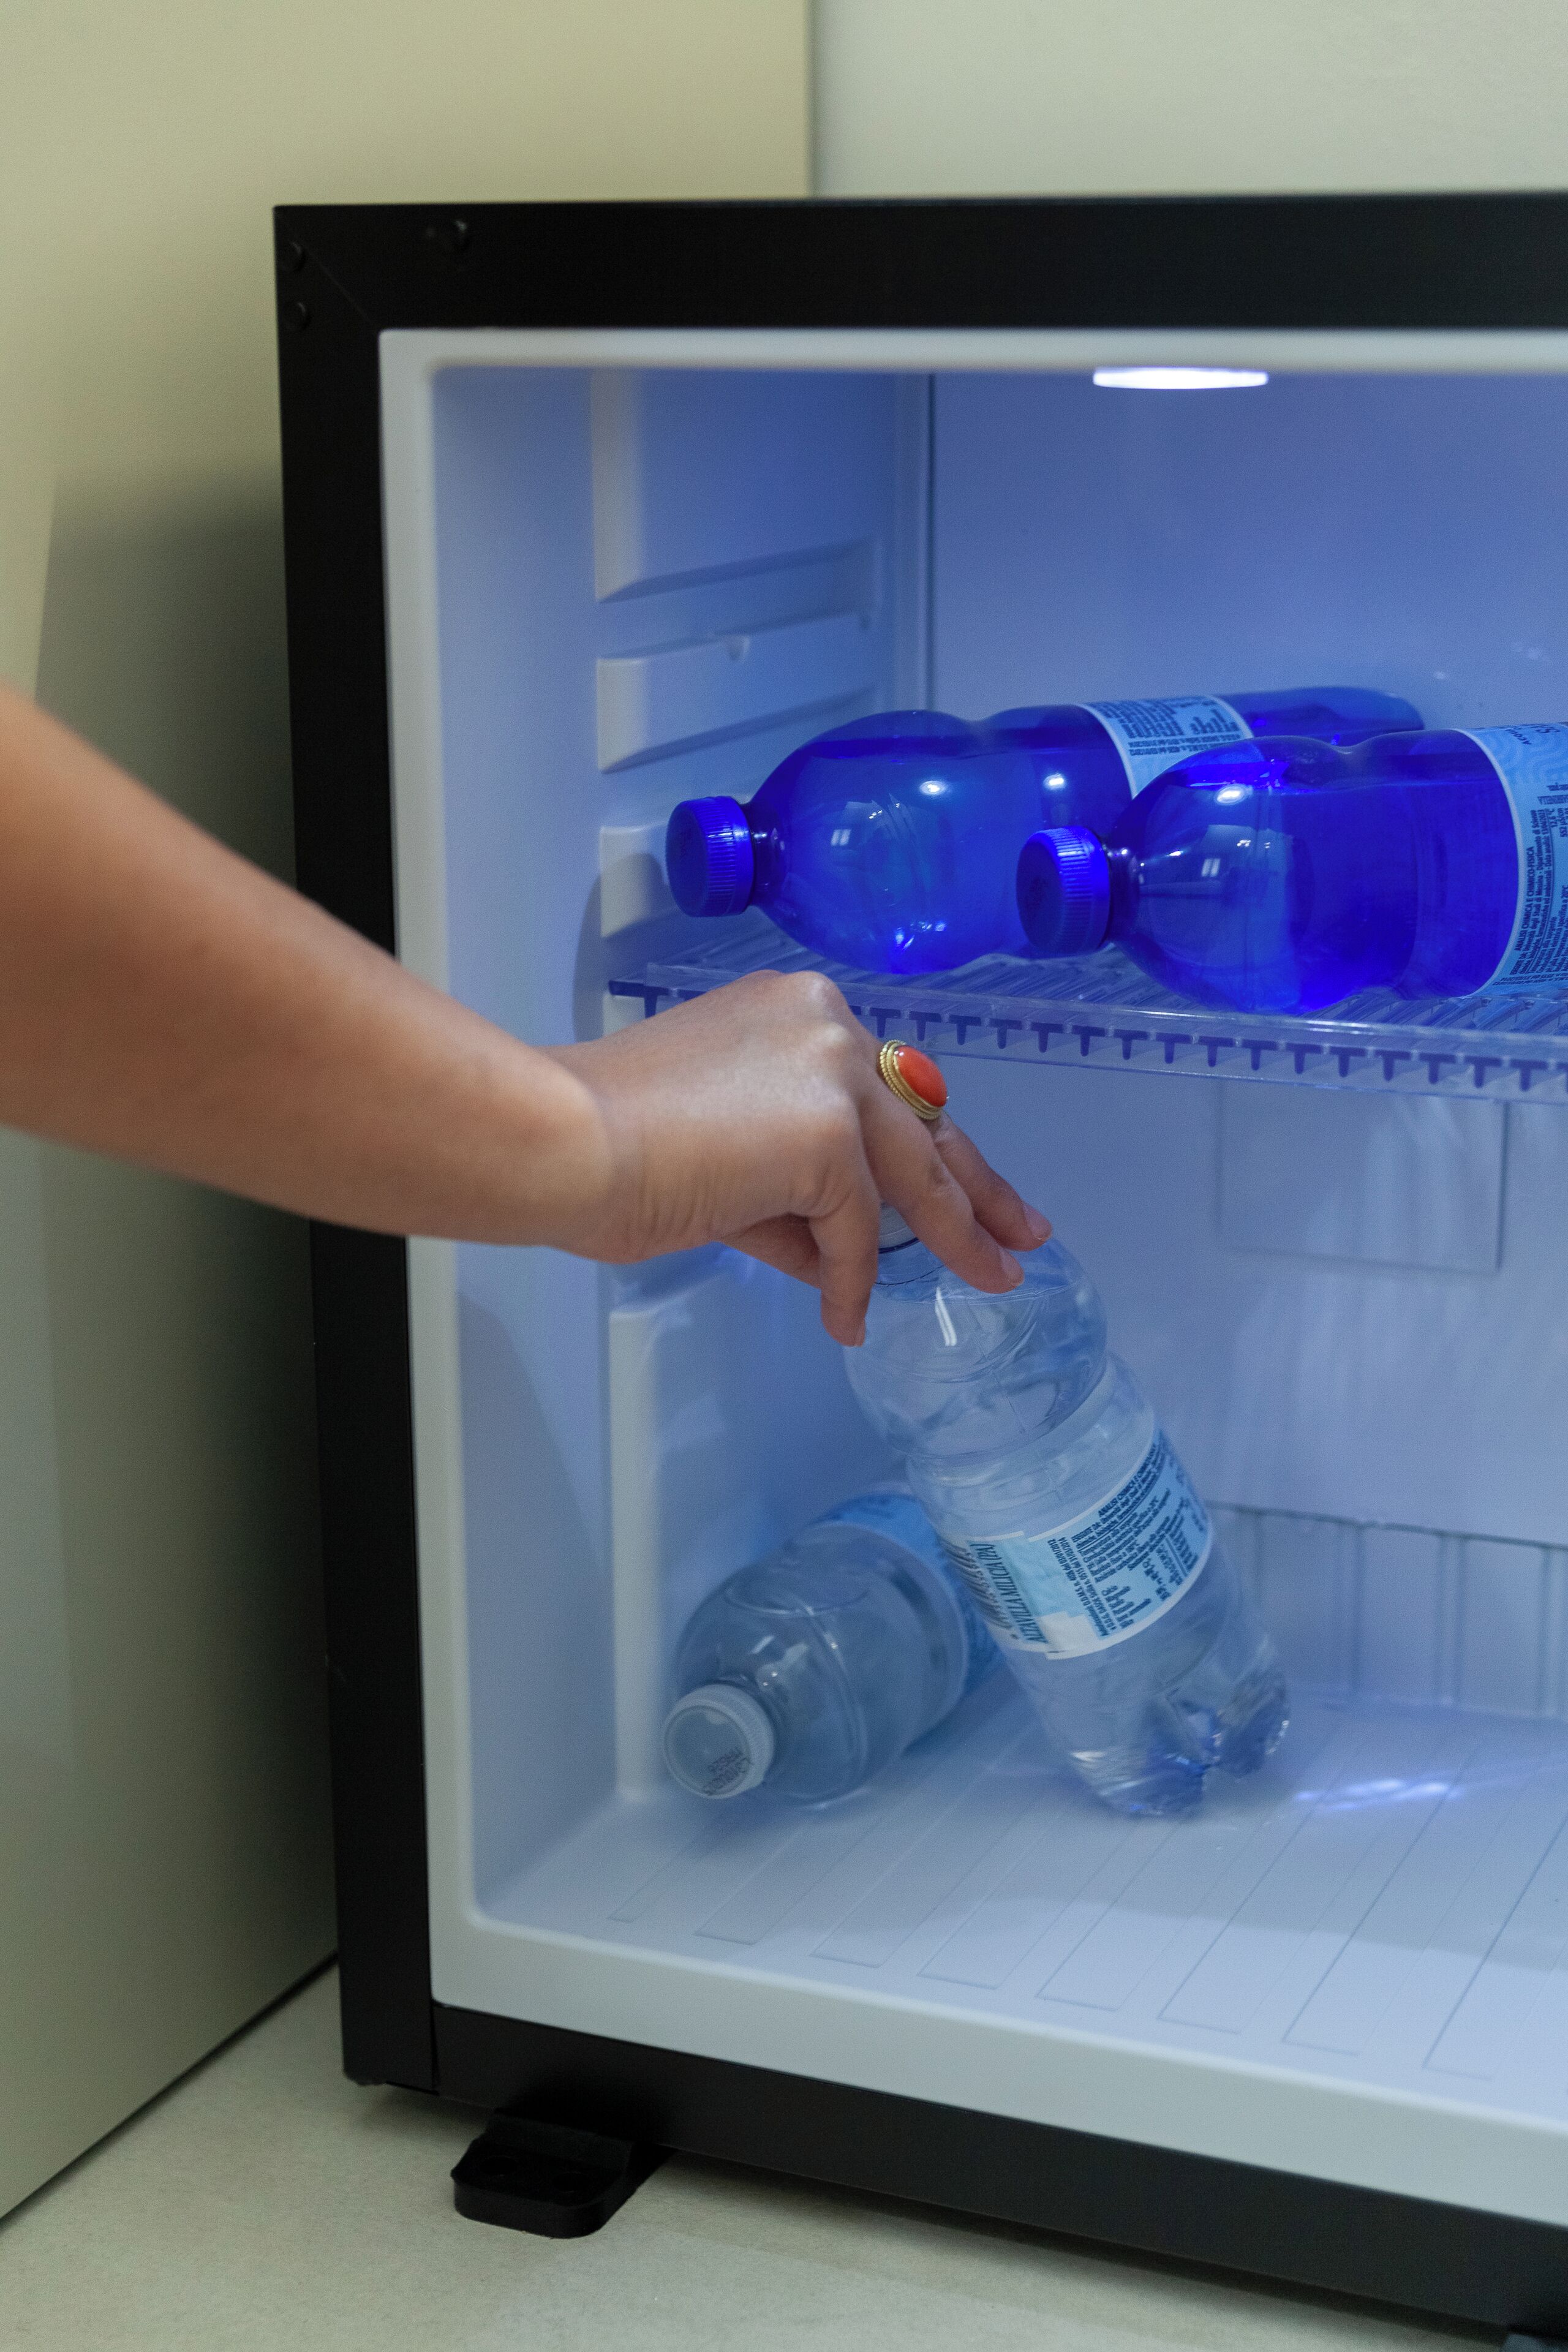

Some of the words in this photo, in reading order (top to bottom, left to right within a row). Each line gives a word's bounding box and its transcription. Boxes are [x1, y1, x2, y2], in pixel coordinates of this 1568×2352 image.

[1534, 835, 1544, 870] Dipartimento
[1526, 846, 1534, 896] CHIMICO-FISICA
[1520, 903, 1532, 929] CHIMICA
[1514, 930, 1527, 951] ANALISI
[969, 1545, 1002, 1562] (PA)
[1047, 1537, 1068, 1565] 03/01/2012
[1057, 1537, 1077, 1562] 31/03/2014
[1061, 1562, 1071, 1572] del
[1071, 1560, 1081, 1569] del
[984, 1561, 1020, 1596] MILICIA
[1005, 1598, 1048, 1643] ALTAVILLA
